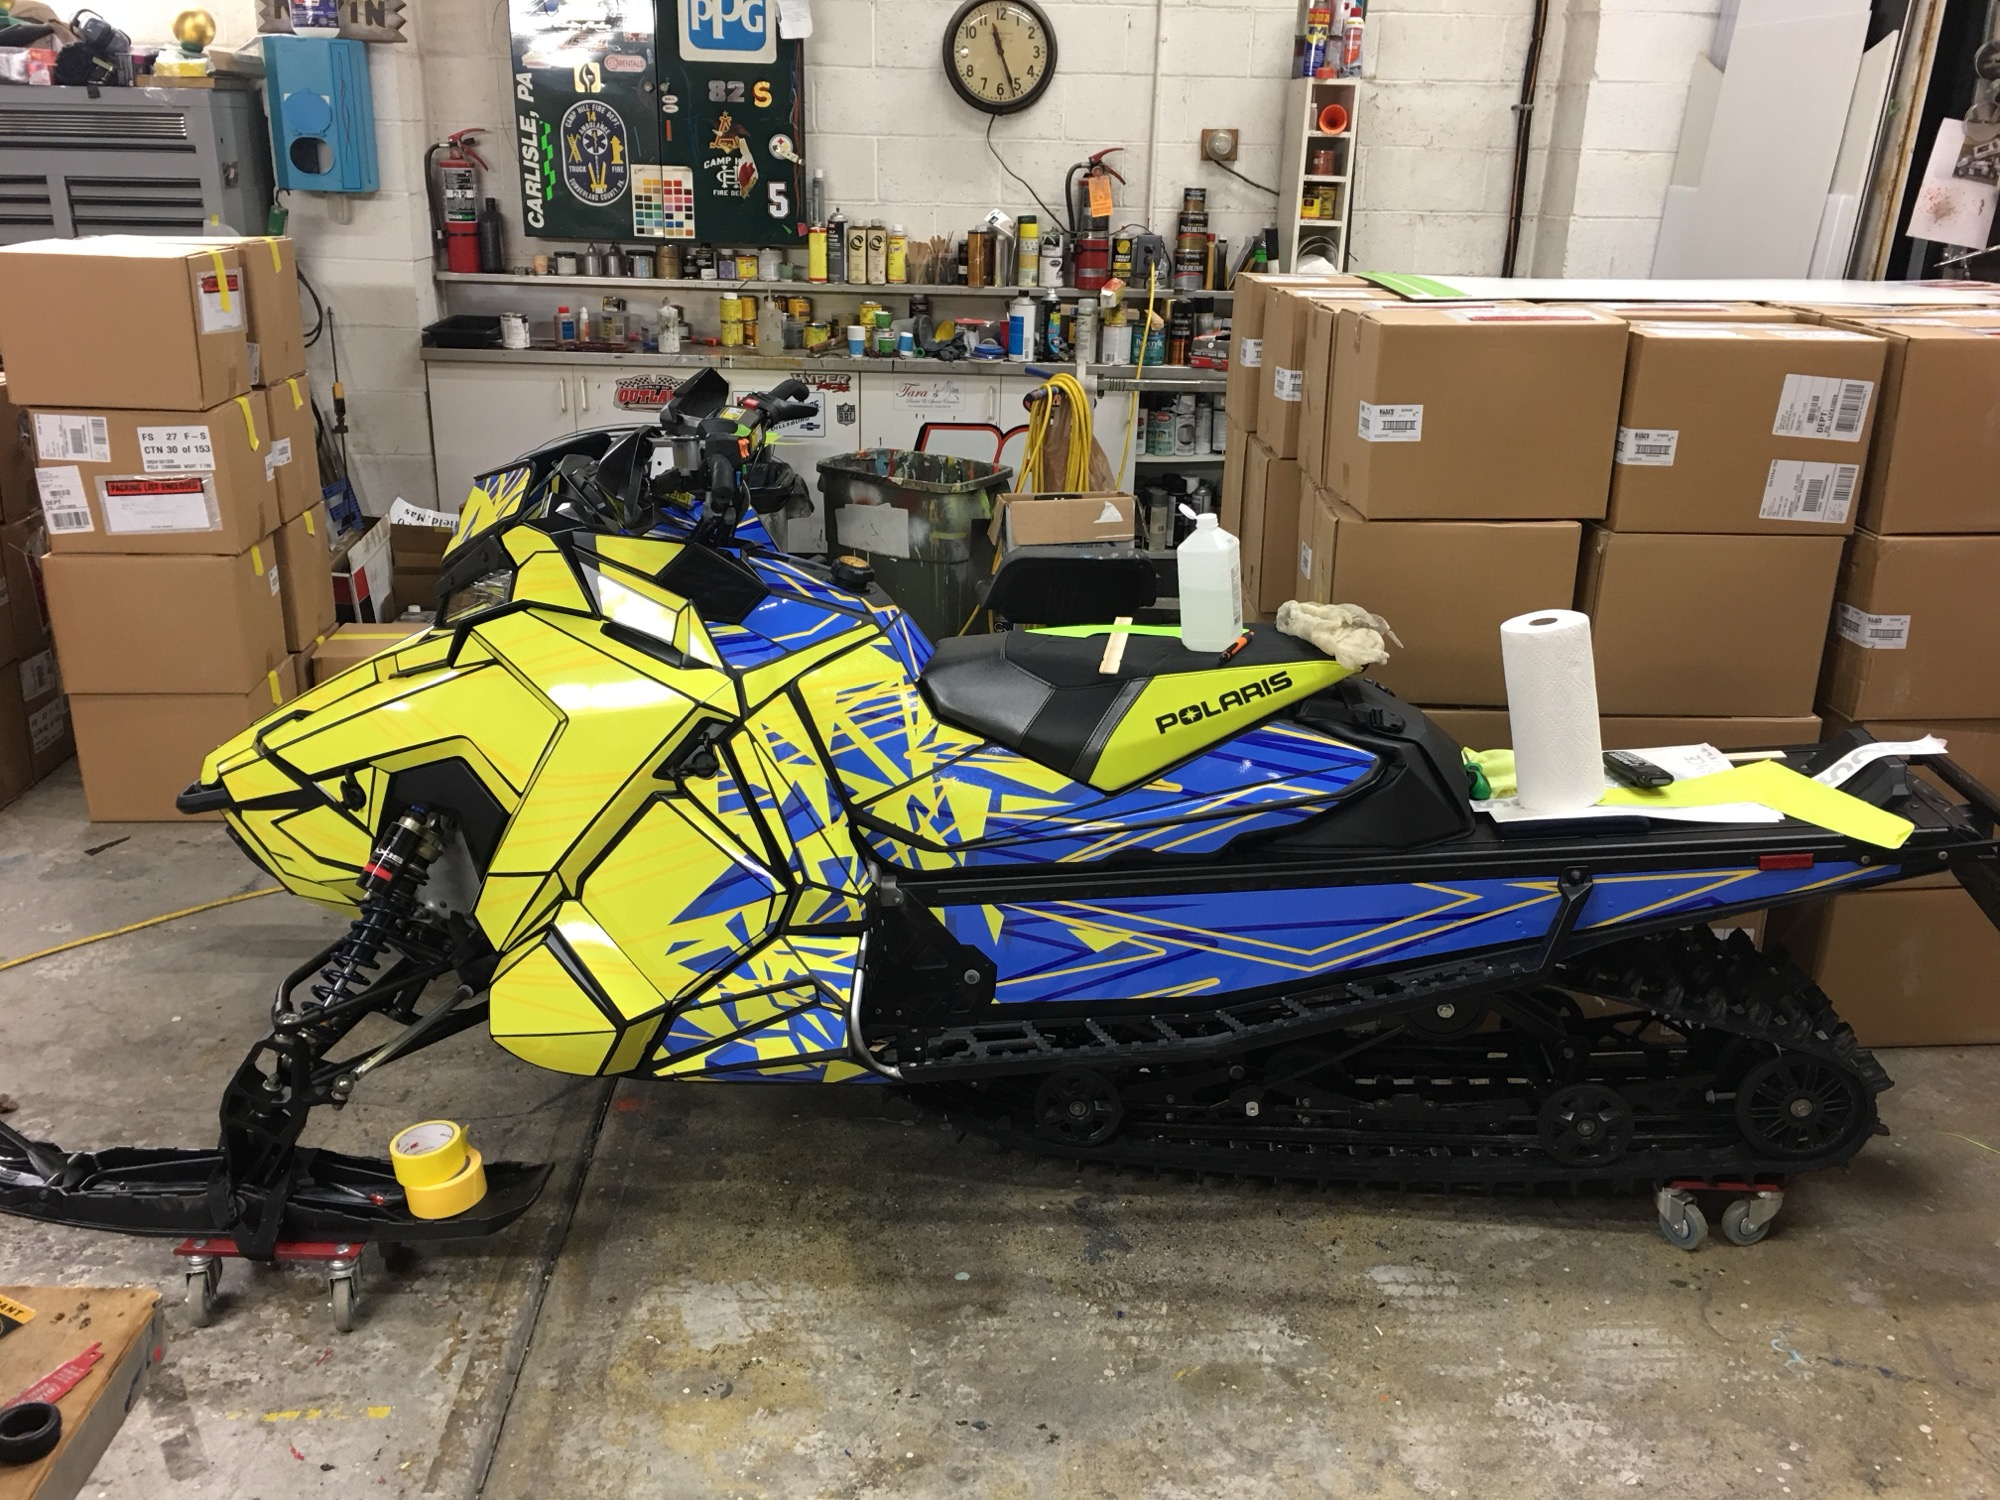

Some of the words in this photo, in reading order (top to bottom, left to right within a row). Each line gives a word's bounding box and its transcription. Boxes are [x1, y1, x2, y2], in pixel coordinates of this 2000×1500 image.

[979, 14, 987, 26] 11
[996, 8, 1007, 21] 12
[1015, 16, 1020, 26] 1
[965, 26, 977, 39] 10
[1028, 26, 1035, 39] 2
[1033, 46, 1040, 59] 3
[620, 60, 644, 68] RENTALS
[966, 65, 974, 77] 8
[1027, 65, 1035, 78] 4
[515, 72, 534, 102] PA
[980, 77, 988, 90] 7
[996, 83, 1004, 96] 6
[1014, 78, 1022, 91] 5
[708, 80, 745, 102] 82
[753, 81, 772, 107] S
[565, 110, 577, 128] CAMP
[577, 104, 590, 113] HILL
[592, 104, 606, 114] FIRE
[586, 111, 596, 122] 14
[578, 121, 611, 135] AMBULANCE
[568, 165, 587, 173] TRUCK
[611, 165, 624, 173] FIRE
[703, 156, 731, 169] CAMP
[519, 111, 545, 228] CARLISLE,
[569, 178, 599, 201] CUMBERLAND
[767, 181, 790, 218] 5
[618, 389, 676, 404] OUTLA
[142, 433, 154, 441] FS
[144, 446, 163, 454] CTN
[166, 445, 178, 454] 30
[194, 445, 211, 453] 153
[110, 484, 142, 492] PACKING
[143, 483, 159, 491] LIST
[161, 481, 198, 490] ENCLOSED
[1155, 670, 1293, 735] POLARIS
